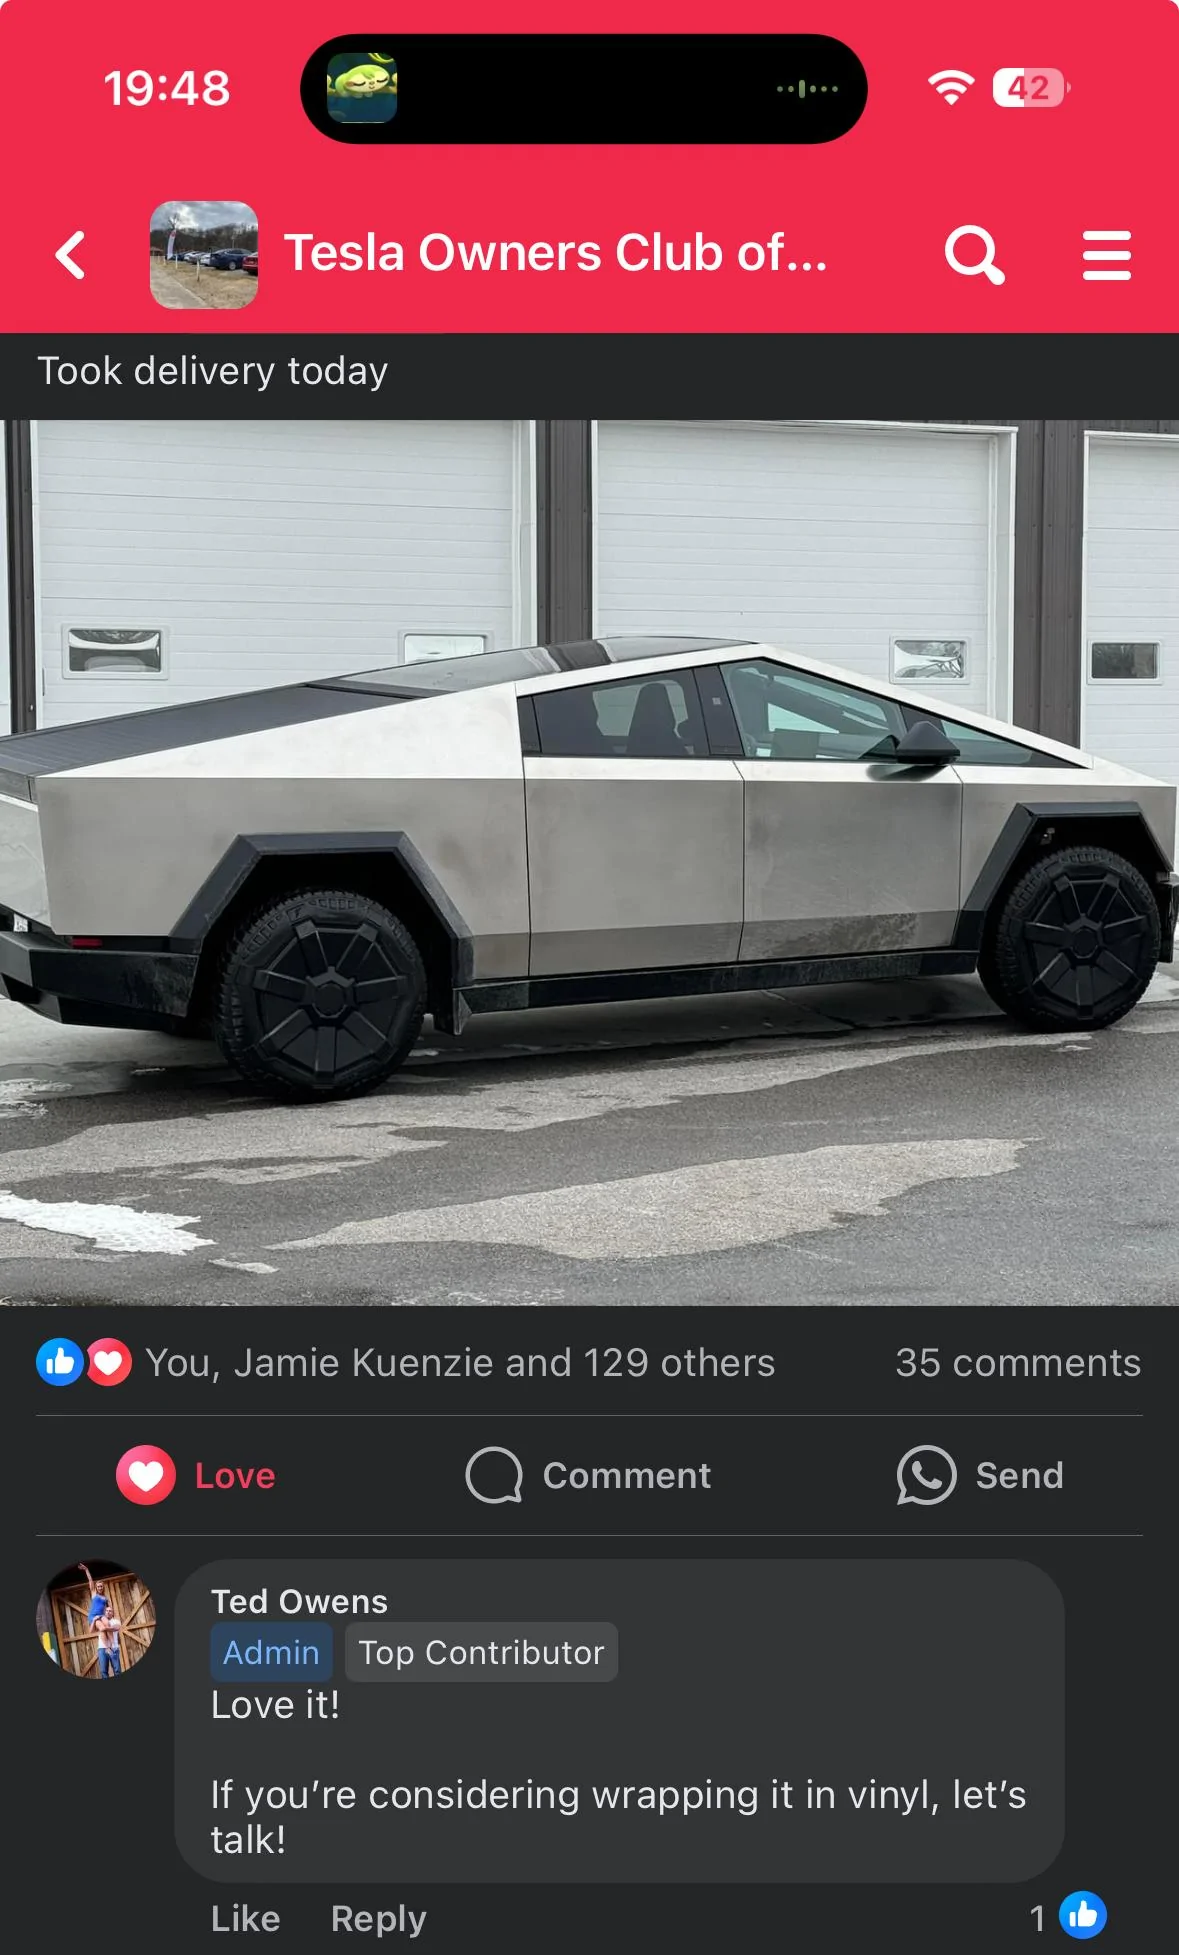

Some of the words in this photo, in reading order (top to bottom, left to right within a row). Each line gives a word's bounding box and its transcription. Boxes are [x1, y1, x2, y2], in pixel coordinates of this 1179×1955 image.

[104, 69, 230, 107] 19:48
[1008, 75, 1048, 99] 42
[283, 231, 404, 272] Tesla
[419, 232, 602, 272] Owners
[616, 231, 723, 272] Club
[37, 354, 123, 385] Took
[134, 354, 276, 392] delivery
[287, 354, 389, 392] today
[145, 1347, 220, 1384] You,
[234, 1346, 339, 1378] Jamie
[353, 1346, 493, 1377] Kuenzie
[506, 1346, 571, 1377] and
[584, 1347, 649, 1378] 129
[661, 1346, 775, 1377] others
[896, 1347, 941, 1378] 35
[953, 1349, 1141, 1377] comments
[196, 1461, 276, 1489] Love
[543, 1461, 712, 1490] Comment
[976, 1460, 1063, 1490] Send
[210, 1587, 268, 1614] Ted
[279, 1588, 388, 1615] Owens
[222, 1639, 319, 1665] Admin
[358, 1640, 414, 1671] Top
[425, 1639, 605, 1666] Contributor
[212, 1689, 294, 1719] Love
[307, 1688, 339, 1719] it!
[212, 1778, 234, 1809] If
[369, 1778, 579, 1816] considering
[591, 1778, 758, 1816] wrapping
[772, 1778, 793, 1809] it
[807, 1778, 835, 1809] in
[848, 1778, 939, 1816] vinyl,
[210, 1823, 285, 1855] talk!
[212, 1902, 281, 1933] Like
[332, 1903, 428, 1939] Reply
[1030, 1904, 1043, 1932] 1
